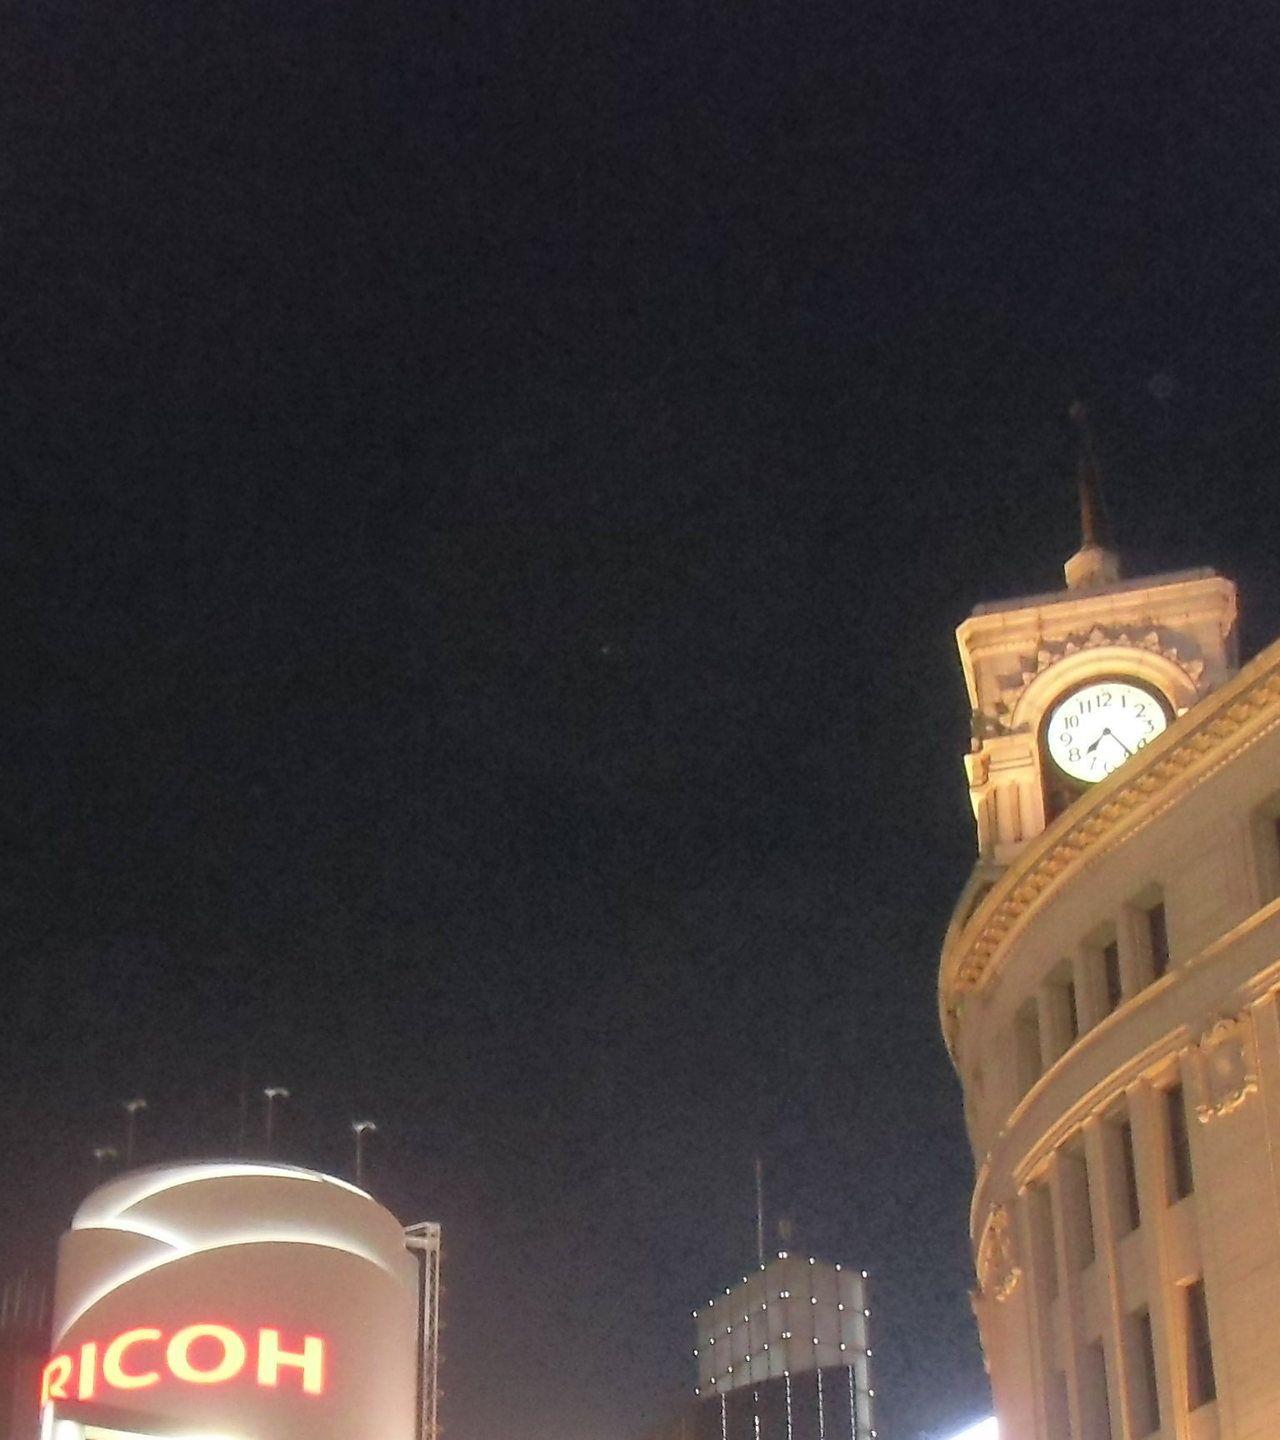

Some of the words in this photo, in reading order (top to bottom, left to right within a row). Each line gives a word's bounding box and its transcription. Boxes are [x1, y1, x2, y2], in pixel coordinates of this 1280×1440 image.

[1079, 699, 1091, 714] 11
[1096, 692, 1112, 708] 12
[1134, 703, 1146, 718] 2
[1064, 715, 1079, 730] 10
[1143, 719, 1155, 734] 3
[1060, 733, 1073, 747] 9
[1068, 747, 1081, 762] 8
[41, 1324, 324, 1403] RICOH
